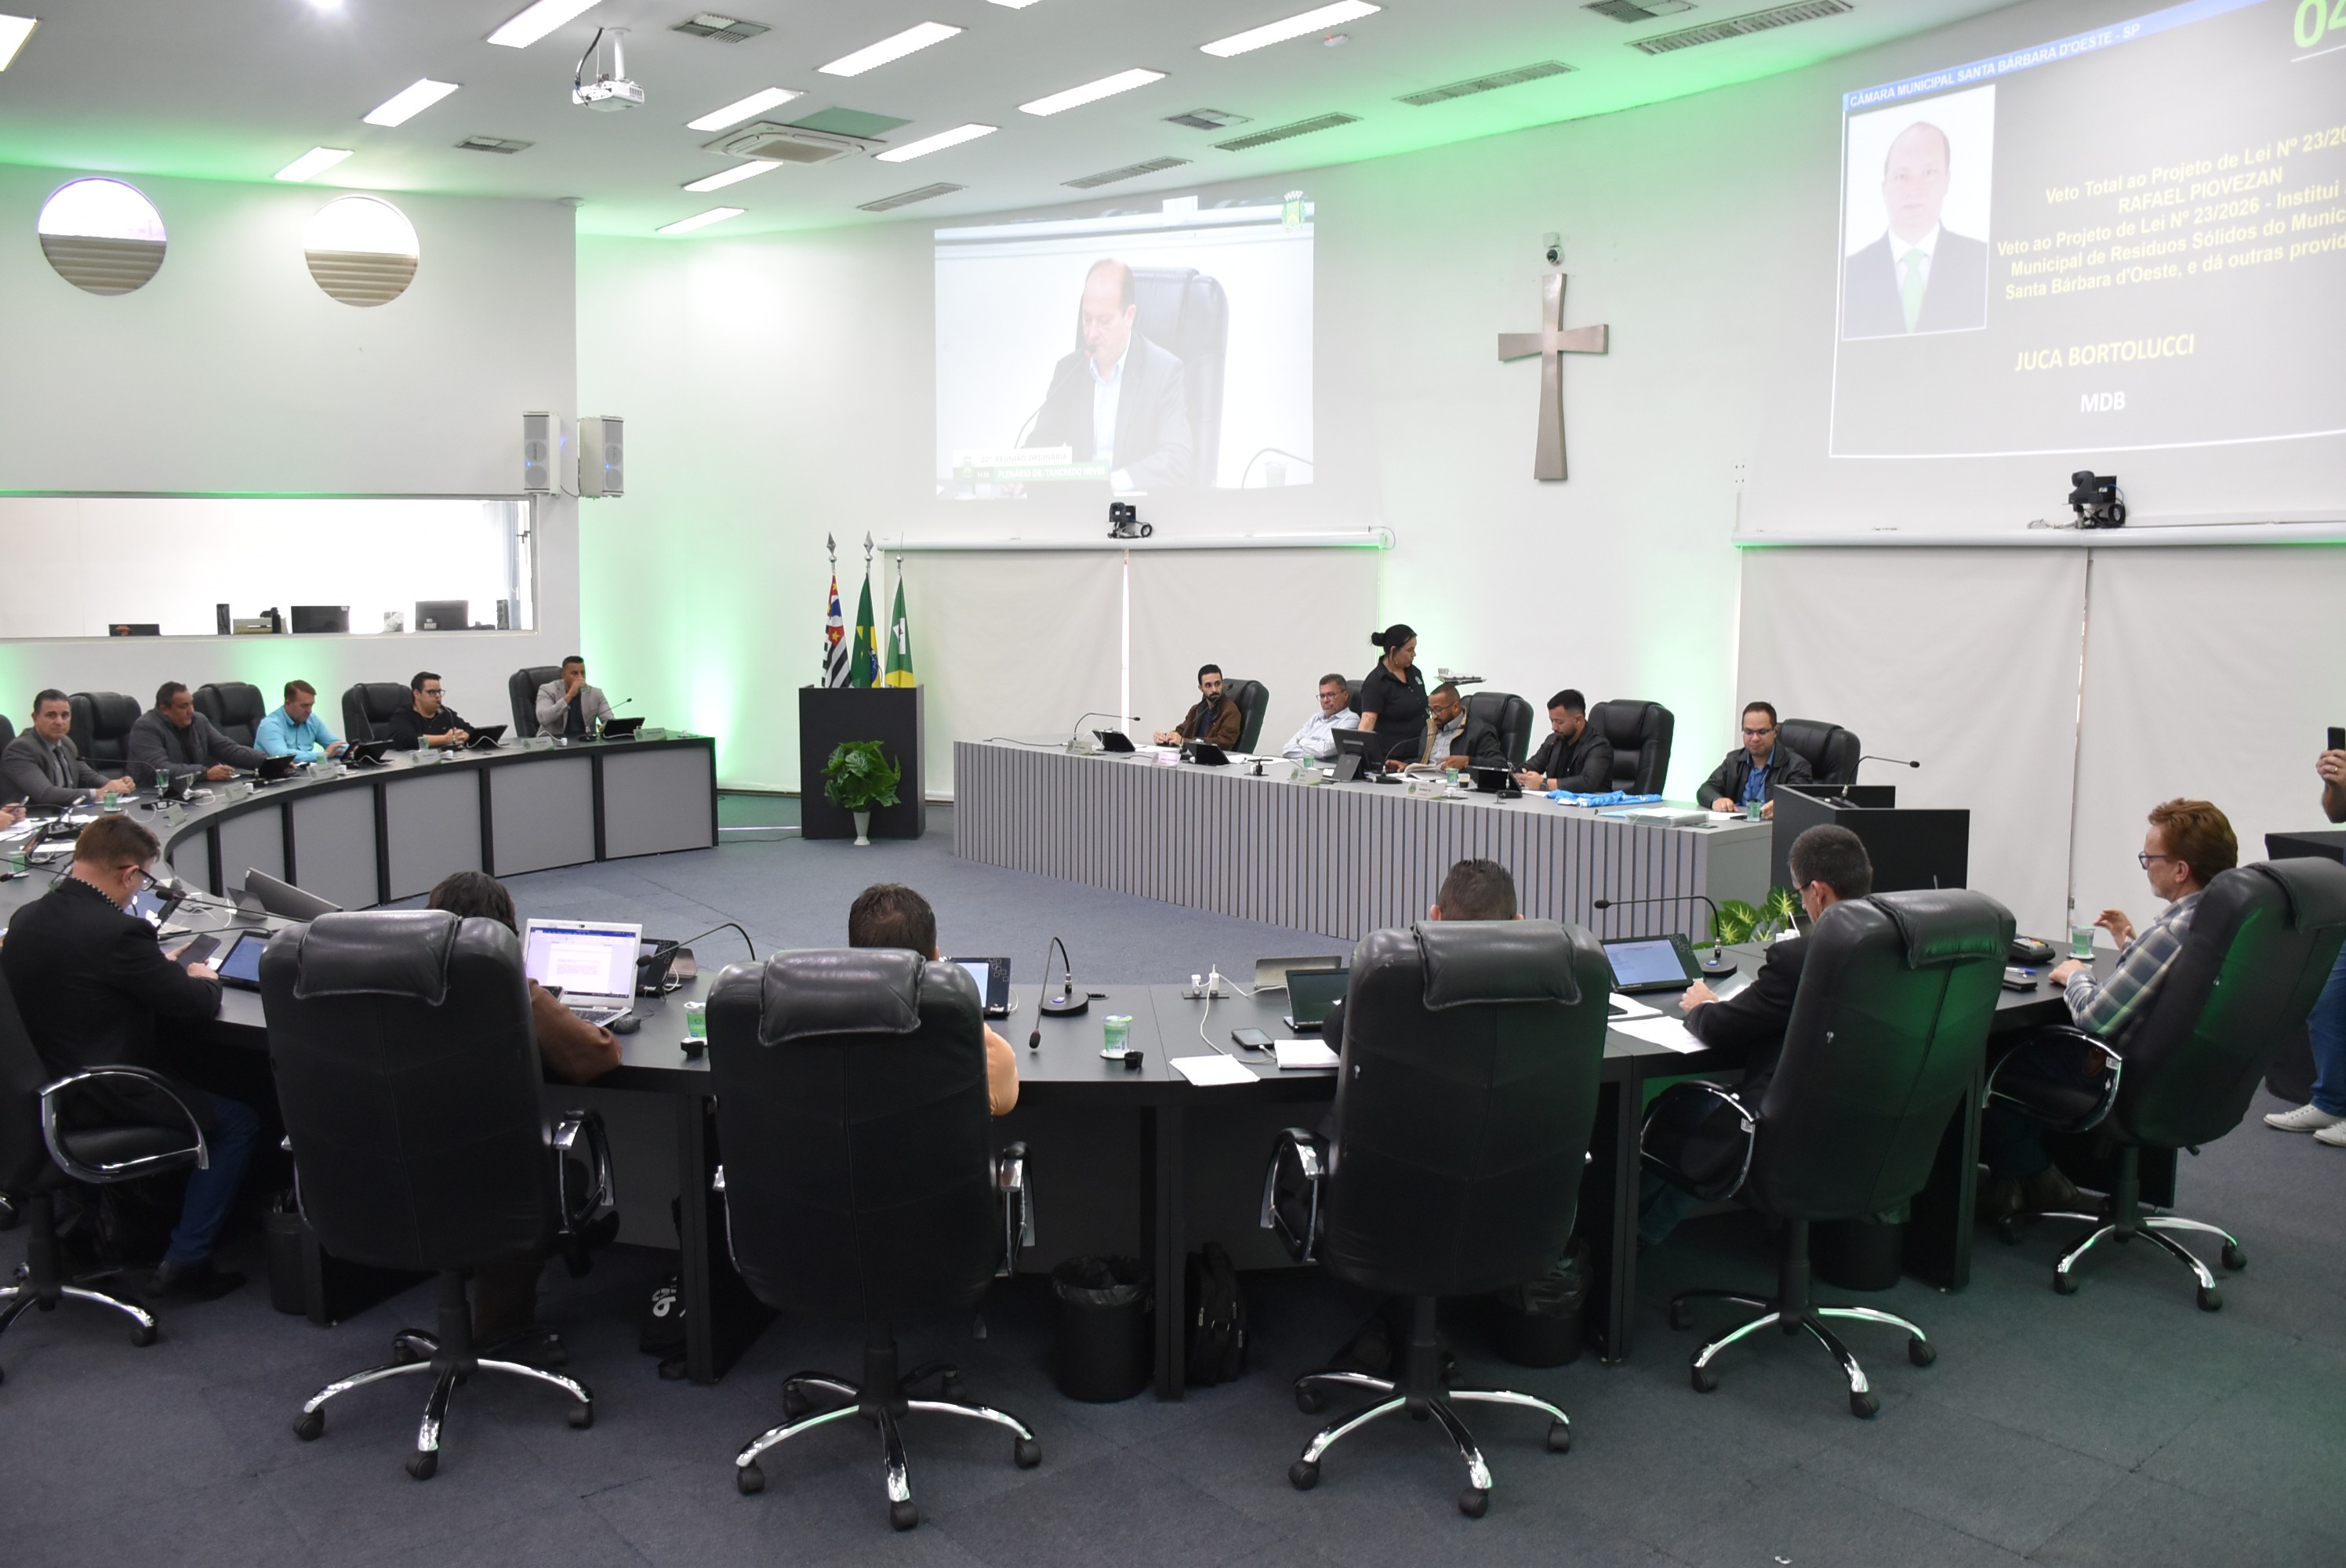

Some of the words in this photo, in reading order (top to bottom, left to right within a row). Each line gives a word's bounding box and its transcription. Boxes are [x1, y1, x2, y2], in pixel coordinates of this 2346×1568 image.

[1850, 89, 1895, 107] CÂMARA
[1898, 74, 1954, 96] MUNICIPAL
[1958, 63, 1996, 82] SANTA
[1998, 49, 2056, 72] BÁRBARA
[2059, 32, 2112, 56] D'OESTE
[2123, 23, 2140, 38] SP
[2046, 187, 2079, 204] Veto
[2084, 176, 2122, 197] Total
[2127, 175, 2147, 188] ao
[2152, 160, 2212, 183] Projeto
[2217, 153, 2239, 170] de
[2245, 143, 2271, 165] Lei
[2119, 187, 2185, 214] RAFAEL
[2191, 166, 2282, 200] PIOVEZAN
[1998, 241, 2028, 256] Veto
[2033, 238, 2051, 251] ao
[2057, 227, 2111, 248] Projeto
[2116, 221, 2136, 238] de
[2141, 214, 2165, 234] Lei
[2194, 197, 2260, 224] 23/2026
[2277, 180, 2339, 209] Institui
[2006, 283, 2046, 299] Santa
[2052, 274, 2111, 294] Bárbara
[2115, 263, 2182, 285] d'Oeste,
[2188, 262, 2197, 274] e
[2203, 253, 2222, 271] dá
[2228, 246, 2283, 267] outras
[2011, 252, 2083, 277] Municipal
[2087, 250, 2105, 265] de
[2111, 239, 2187, 262] Resíduos
[2192, 226, 2257, 249] Sólidos
[2263, 219, 2286, 236] do
[2015, 349, 2062, 372] JUCA
[2068, 333, 2195, 366] BORTOLUCCI
[2081, 391, 2126, 412] MDB
